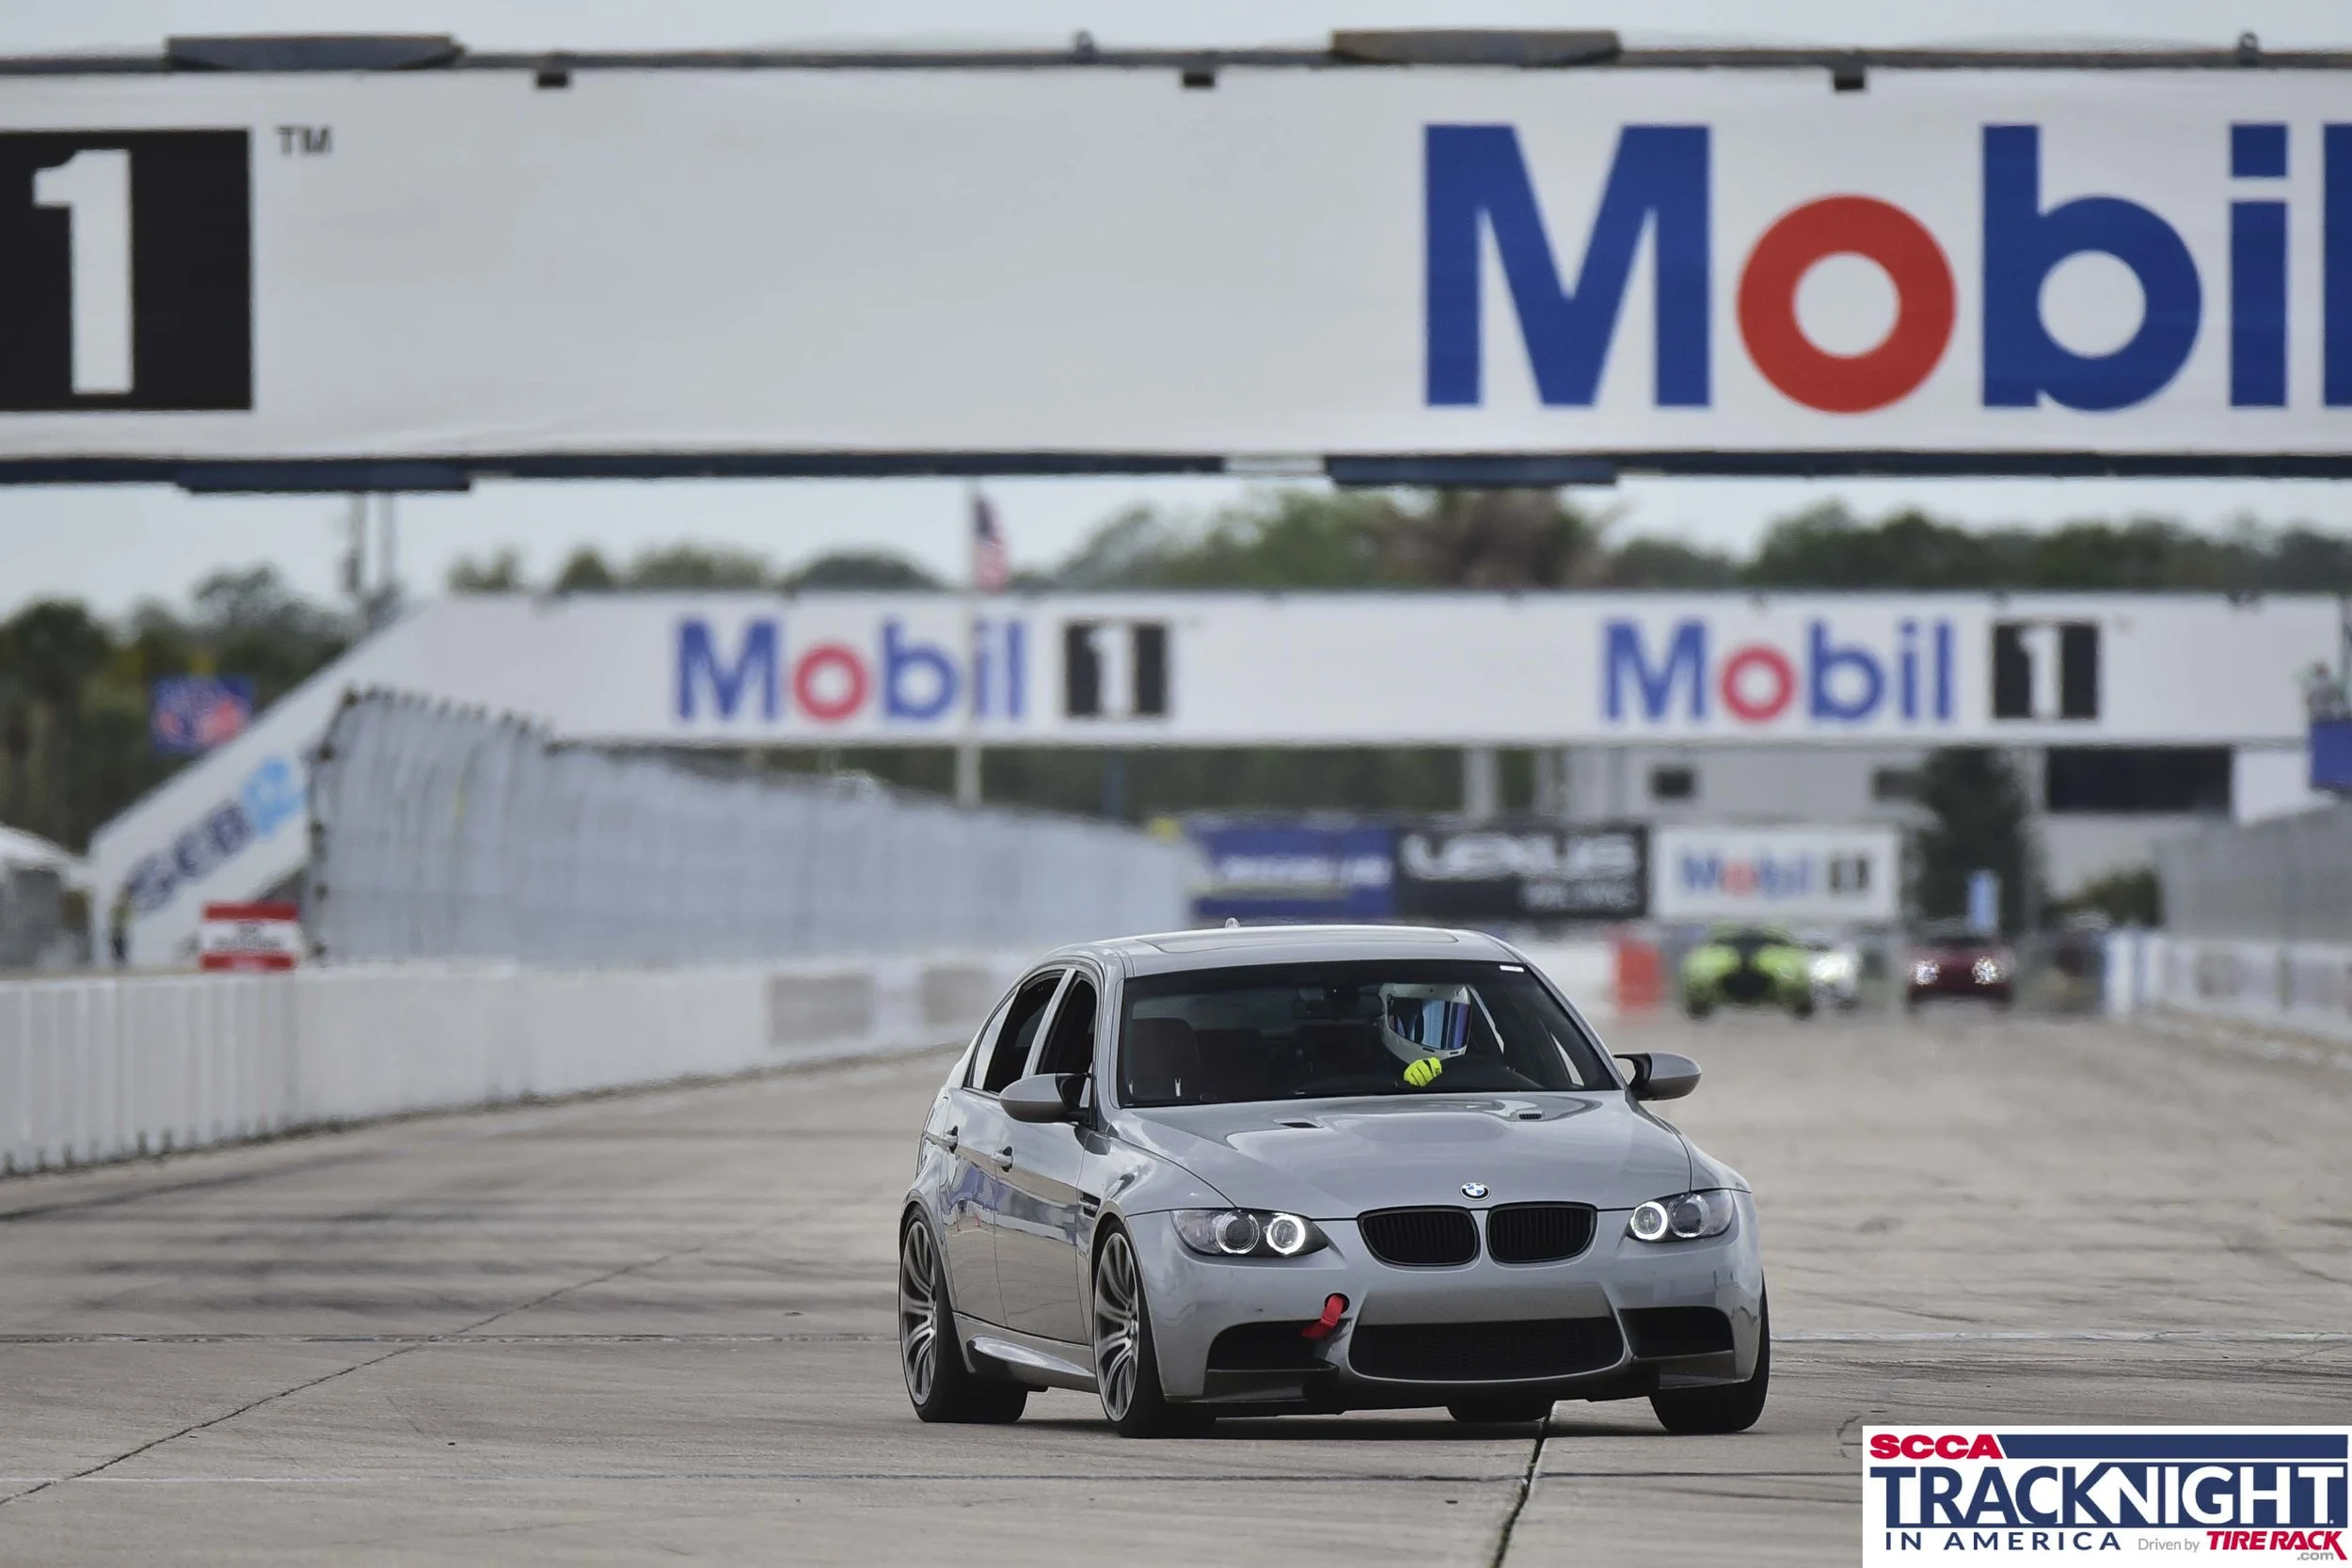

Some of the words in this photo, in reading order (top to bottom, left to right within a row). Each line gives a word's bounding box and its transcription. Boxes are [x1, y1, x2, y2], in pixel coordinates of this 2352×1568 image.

[33, 148, 134, 395] 1
[278, 126, 332, 155] TM
[676, 618, 1027, 721] Mobil
[1604, 618, 1953, 721] Mobil
